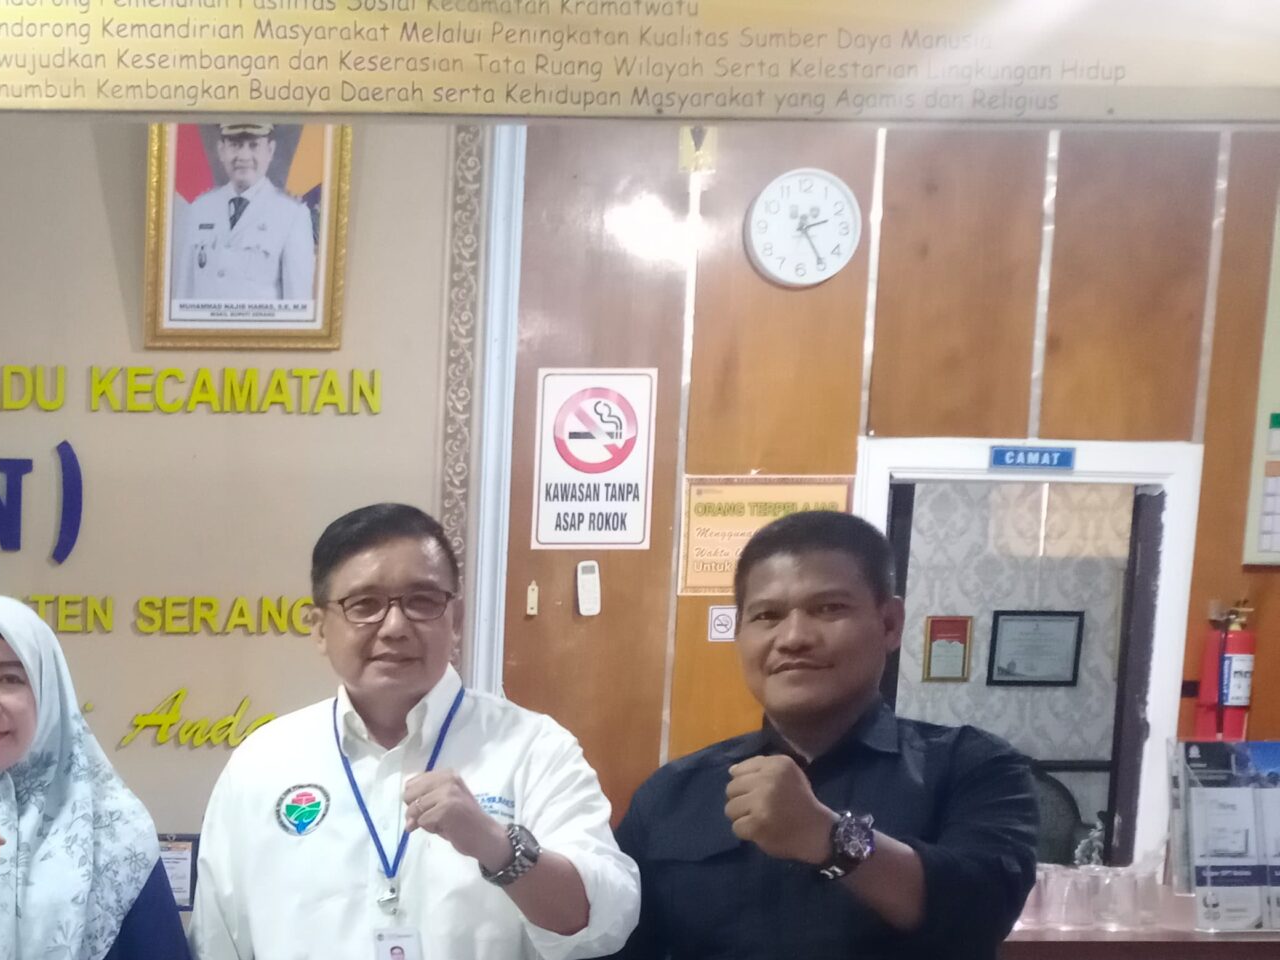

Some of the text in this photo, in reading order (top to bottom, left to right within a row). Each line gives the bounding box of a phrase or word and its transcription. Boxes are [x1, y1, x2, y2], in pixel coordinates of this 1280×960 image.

[101, 16, 244, 40] Kemandirian
[253, 19, 391, 48] Masyarakat
[399, 21, 482, 44] Melalui
[491, 22, 629, 51] Peningkatan
[639, 26, 729, 48] Kualitas
[739, 27, 828, 50] Sumber
[837, 27, 892, 54] Daya
[117, 48, 280, 76] Keseimbangan
[288, 49, 328, 72] dan
[339, 50, 464, 73] Keserasian
[474, 53, 526, 75] Tata
[535, 54, 603, 82] Ruang
[614, 56, 704, 83] Wilayah
[715, 57, 780, 79] Serta
[790, 58, 919, 81] Kelestarian
[926, 58, 1052, 87] Lingkungan
[1061, 59, 1127, 85] Hidup
[97, 78, 239, 106] Kembangkan
[249, 79, 331, 107] Budaya
[340, 80, 424, 102] Daerah
[432, 83, 496, 103] serta
[505, 84, 621, 111] Kehidupan
[630, 86, 765, 113] Masyarakat
[776, 91, 825, 114] yang
[835, 88, 914, 116] Agamis
[924, 89, 961, 110] dan
[89, 365, 382, 416] KECAMATAN
[1005, 451, 1061, 466] CAMAT
[544, 482, 640, 503] KAWASAN TANPA
[694, 501, 746, 517] ORANG
[554, 511, 628, 532] ASAP ROKOK
[694, 562, 732, 575] Untuk
